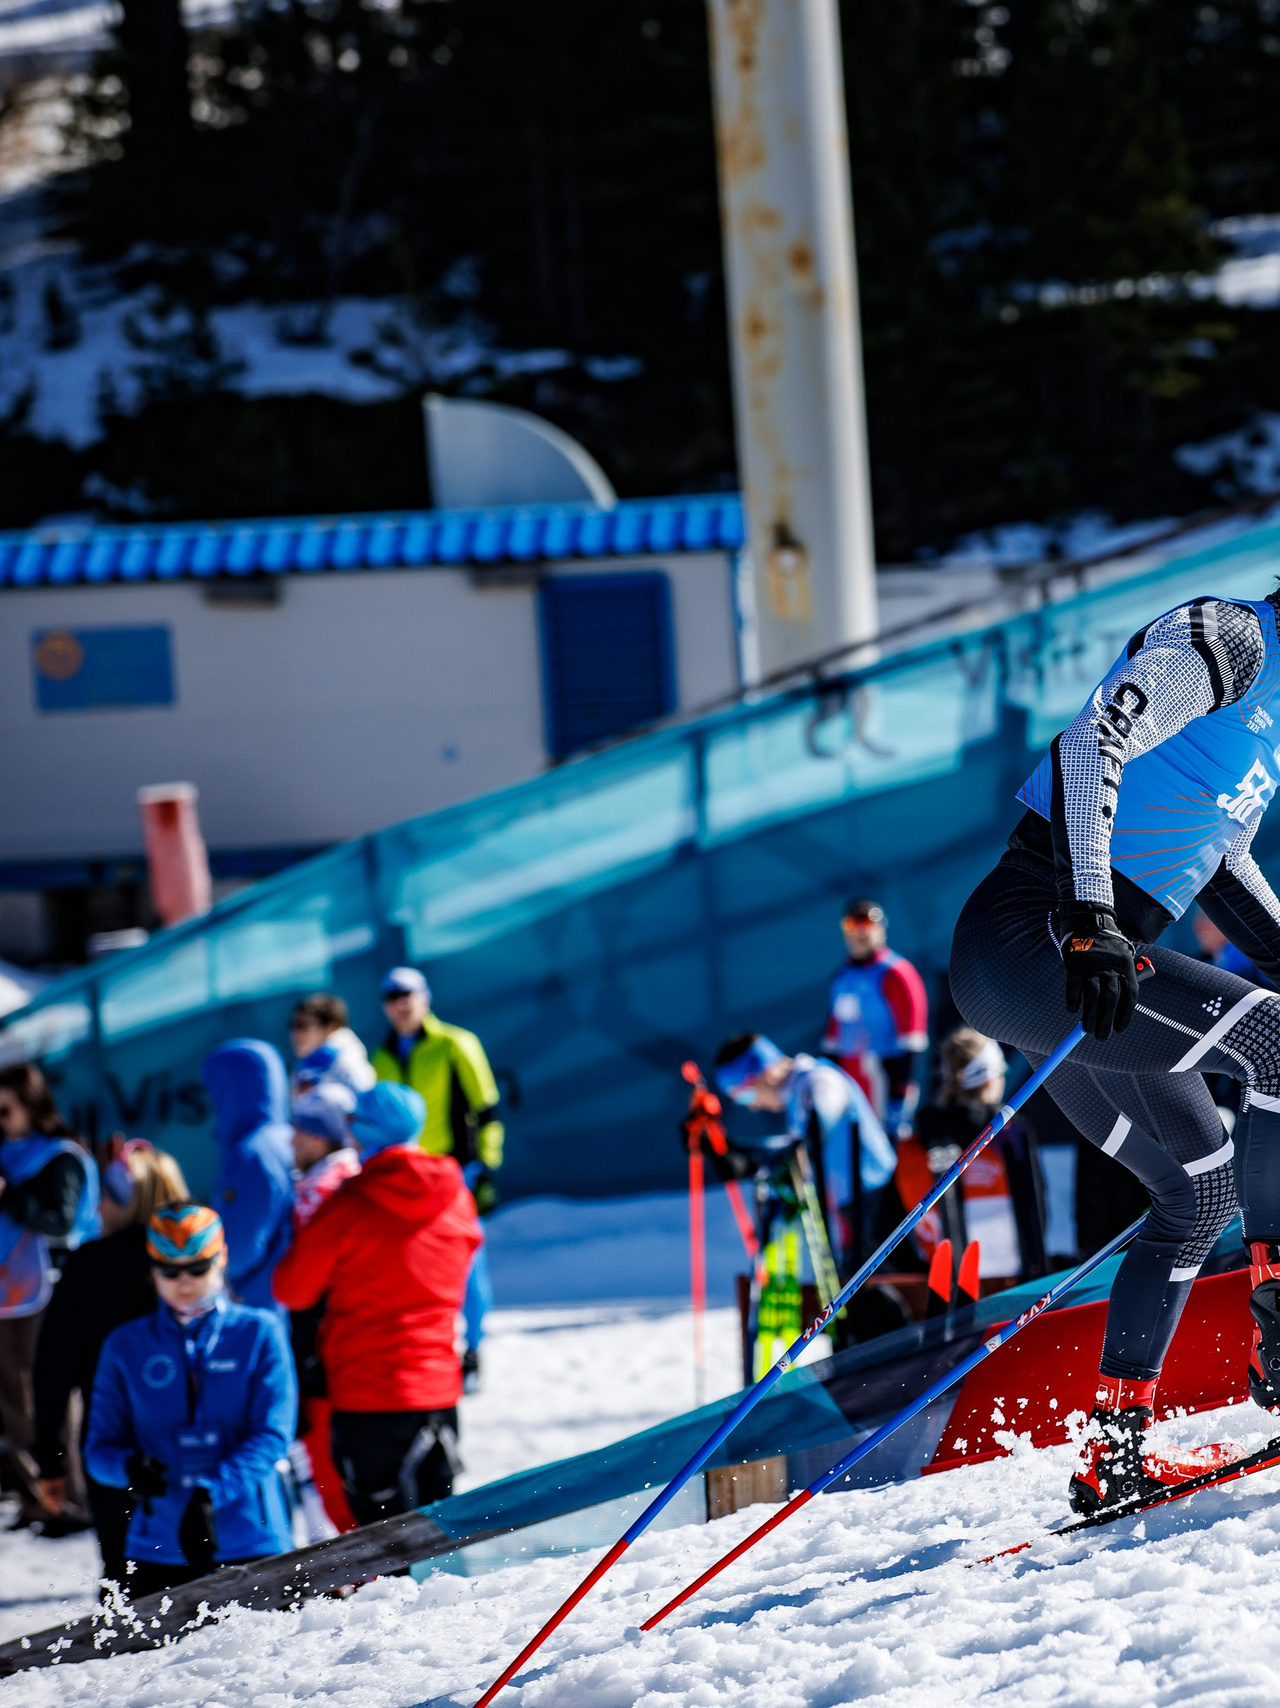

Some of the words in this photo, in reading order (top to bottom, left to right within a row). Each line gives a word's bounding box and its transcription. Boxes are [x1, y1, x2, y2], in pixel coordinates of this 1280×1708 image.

[1246, 720, 1261, 734] 2025
[923, 1165, 956, 1203] FORZA
[802, 1302, 834, 1342] KV+
[1016, 1292, 1051, 1328] KV+
